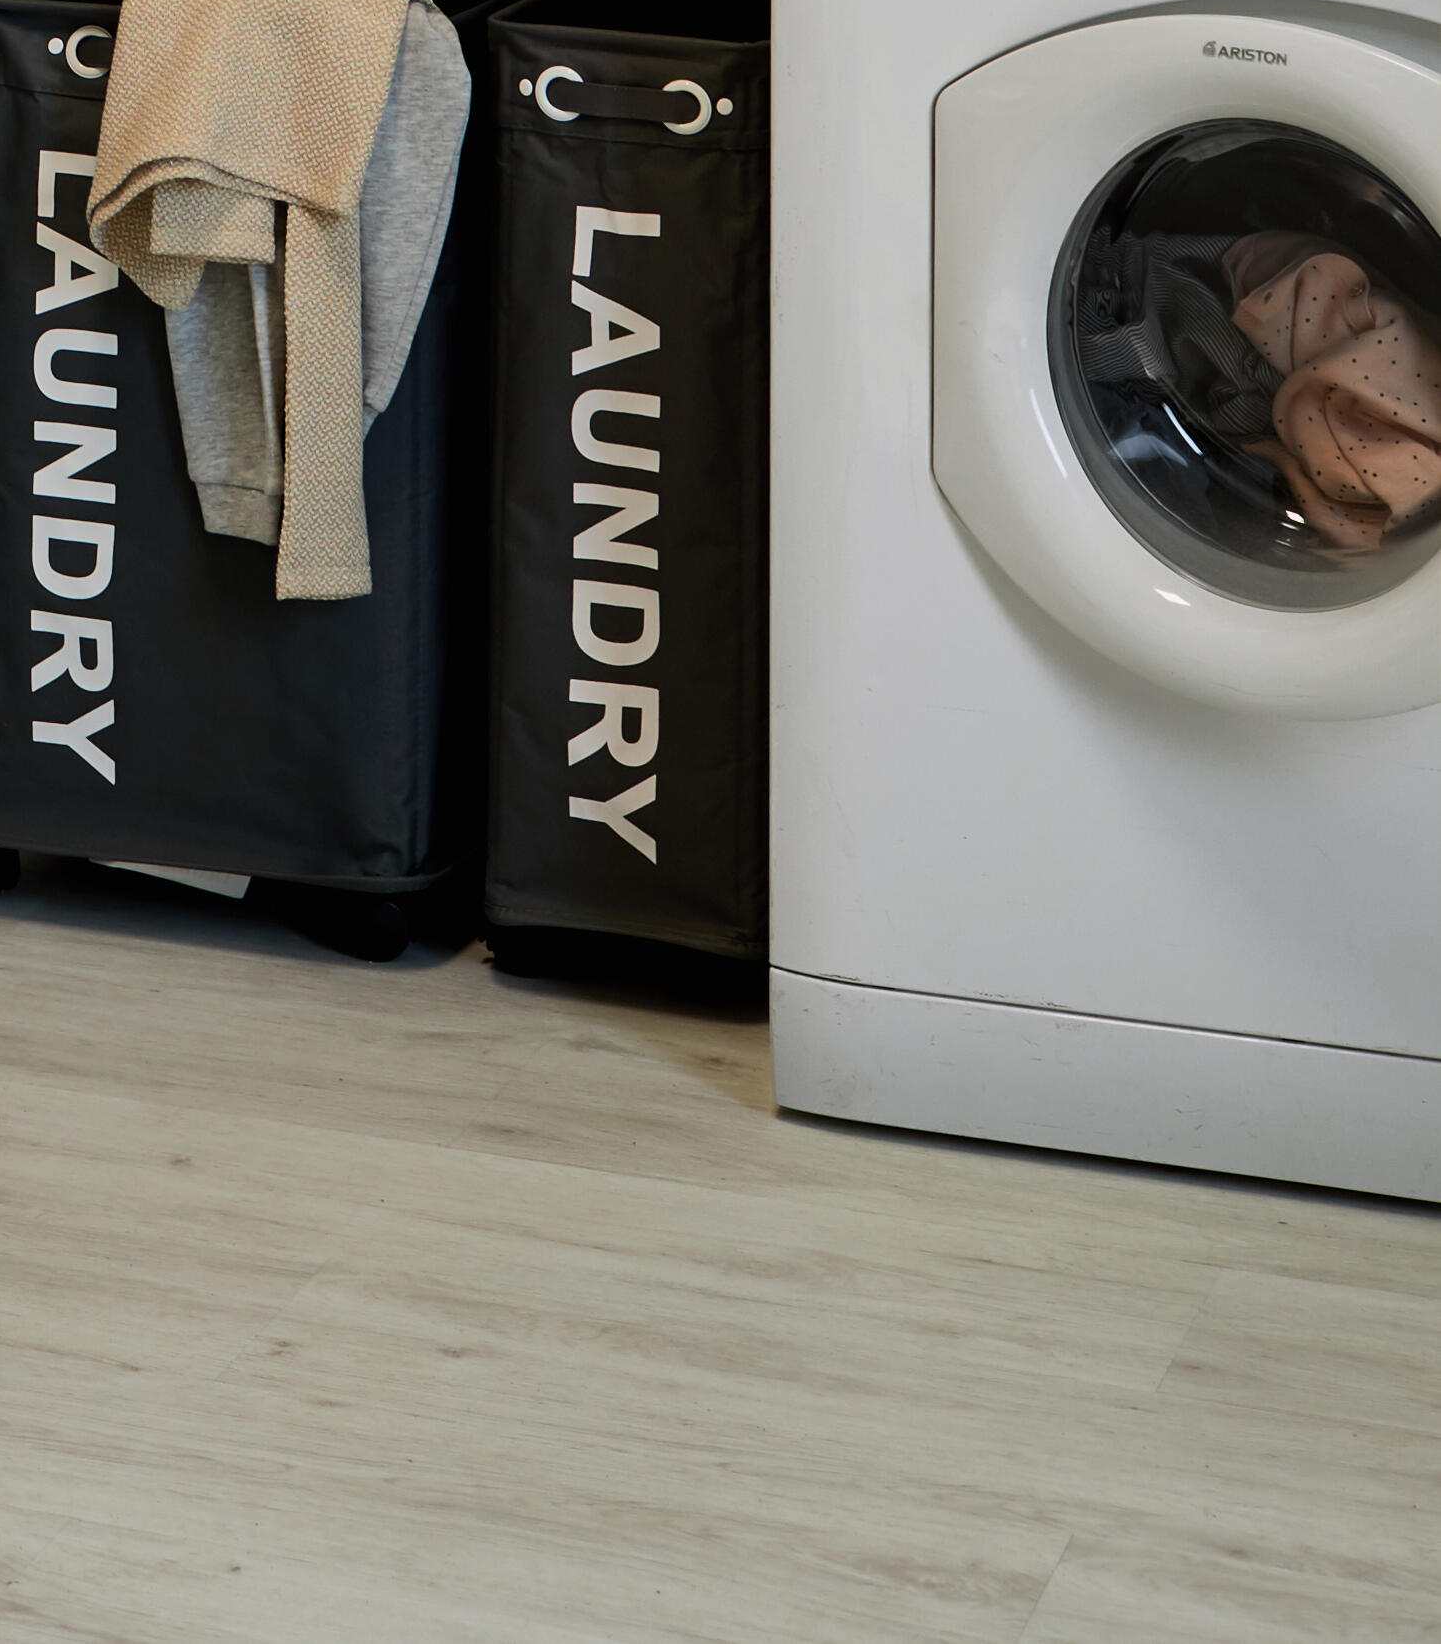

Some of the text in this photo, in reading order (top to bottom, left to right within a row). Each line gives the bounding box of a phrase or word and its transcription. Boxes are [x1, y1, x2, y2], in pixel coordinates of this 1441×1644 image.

[1217, 45, 1288, 67] ARISTON
[30, 148, 120, 787] LAUNDRY
[567, 205, 663, 867] LAUNDRY
